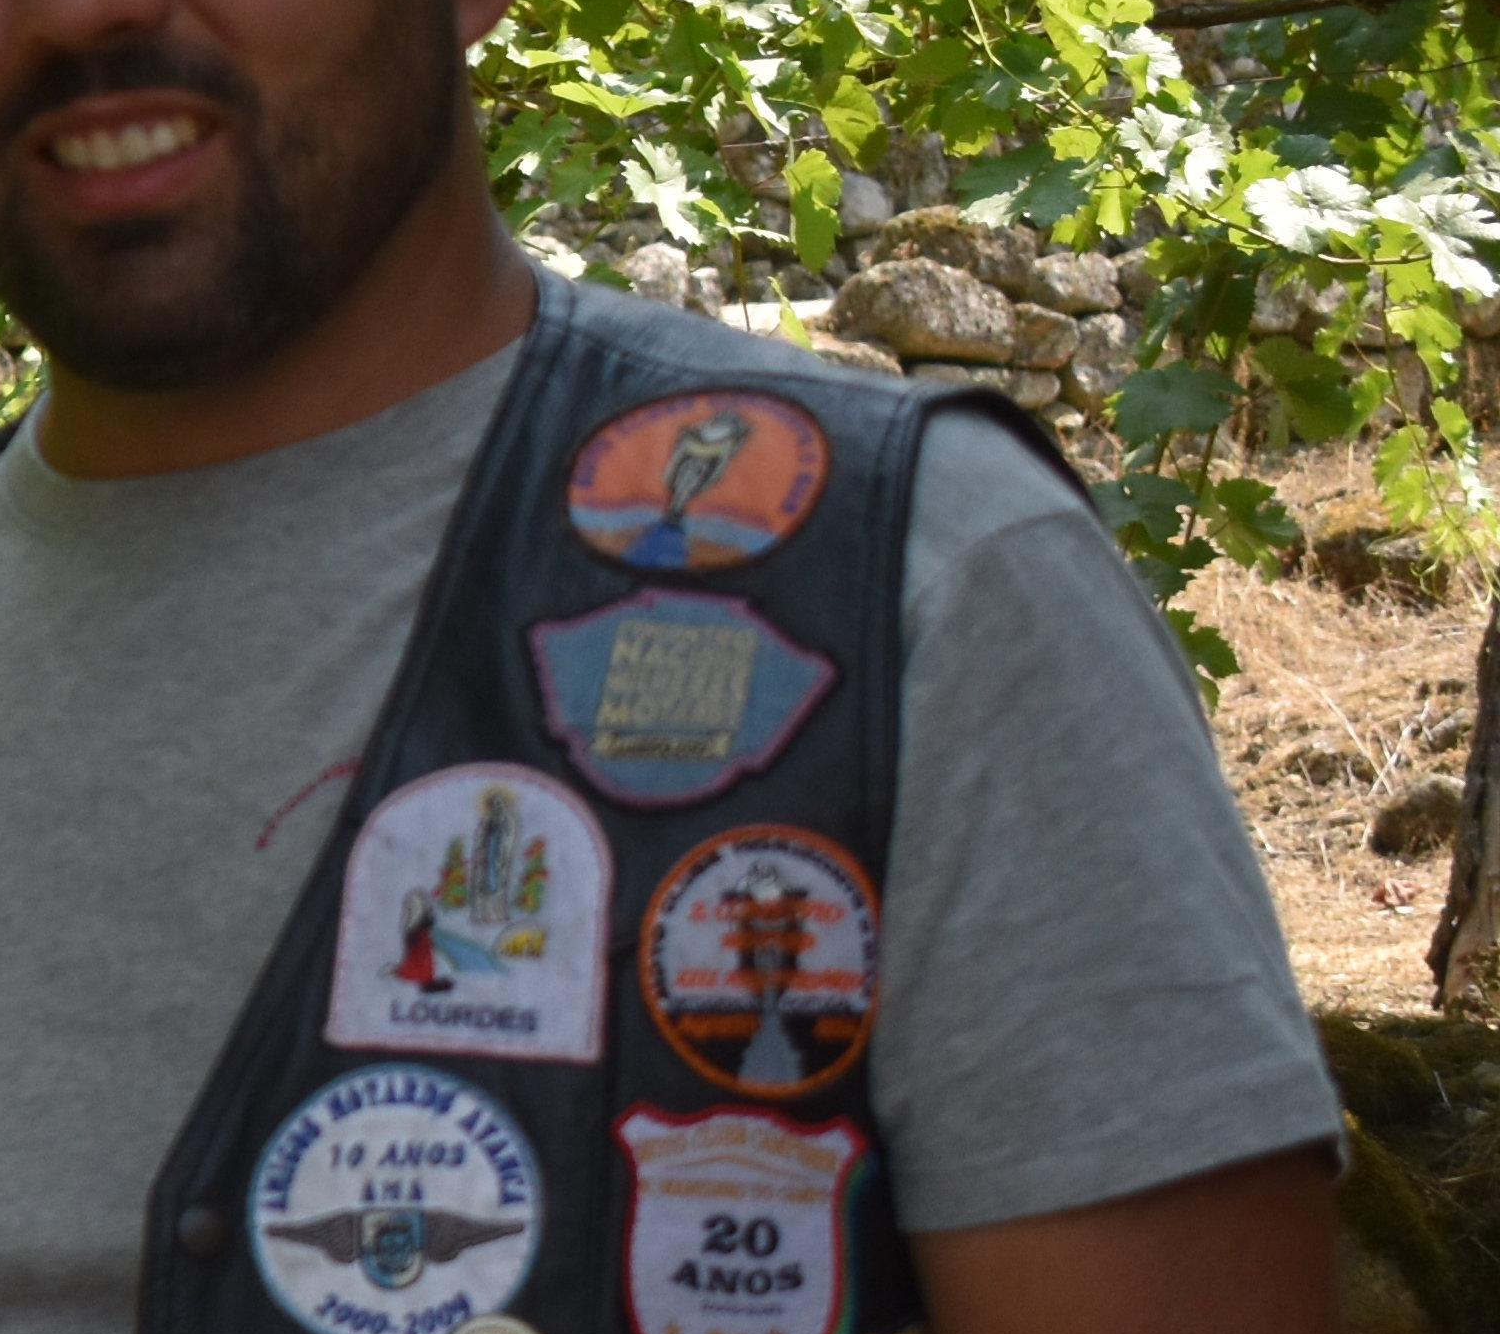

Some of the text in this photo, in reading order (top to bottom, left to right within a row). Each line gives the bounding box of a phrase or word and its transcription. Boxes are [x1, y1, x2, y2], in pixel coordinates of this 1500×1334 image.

[390, 998, 540, 1034] LOURDES
[330, 1140, 466, 1170] 10 ANOS
[360, 1179, 423, 1202] AMA
[702, 1213, 780, 1258] 20
[670, 1260, 805, 1297] ANOS
